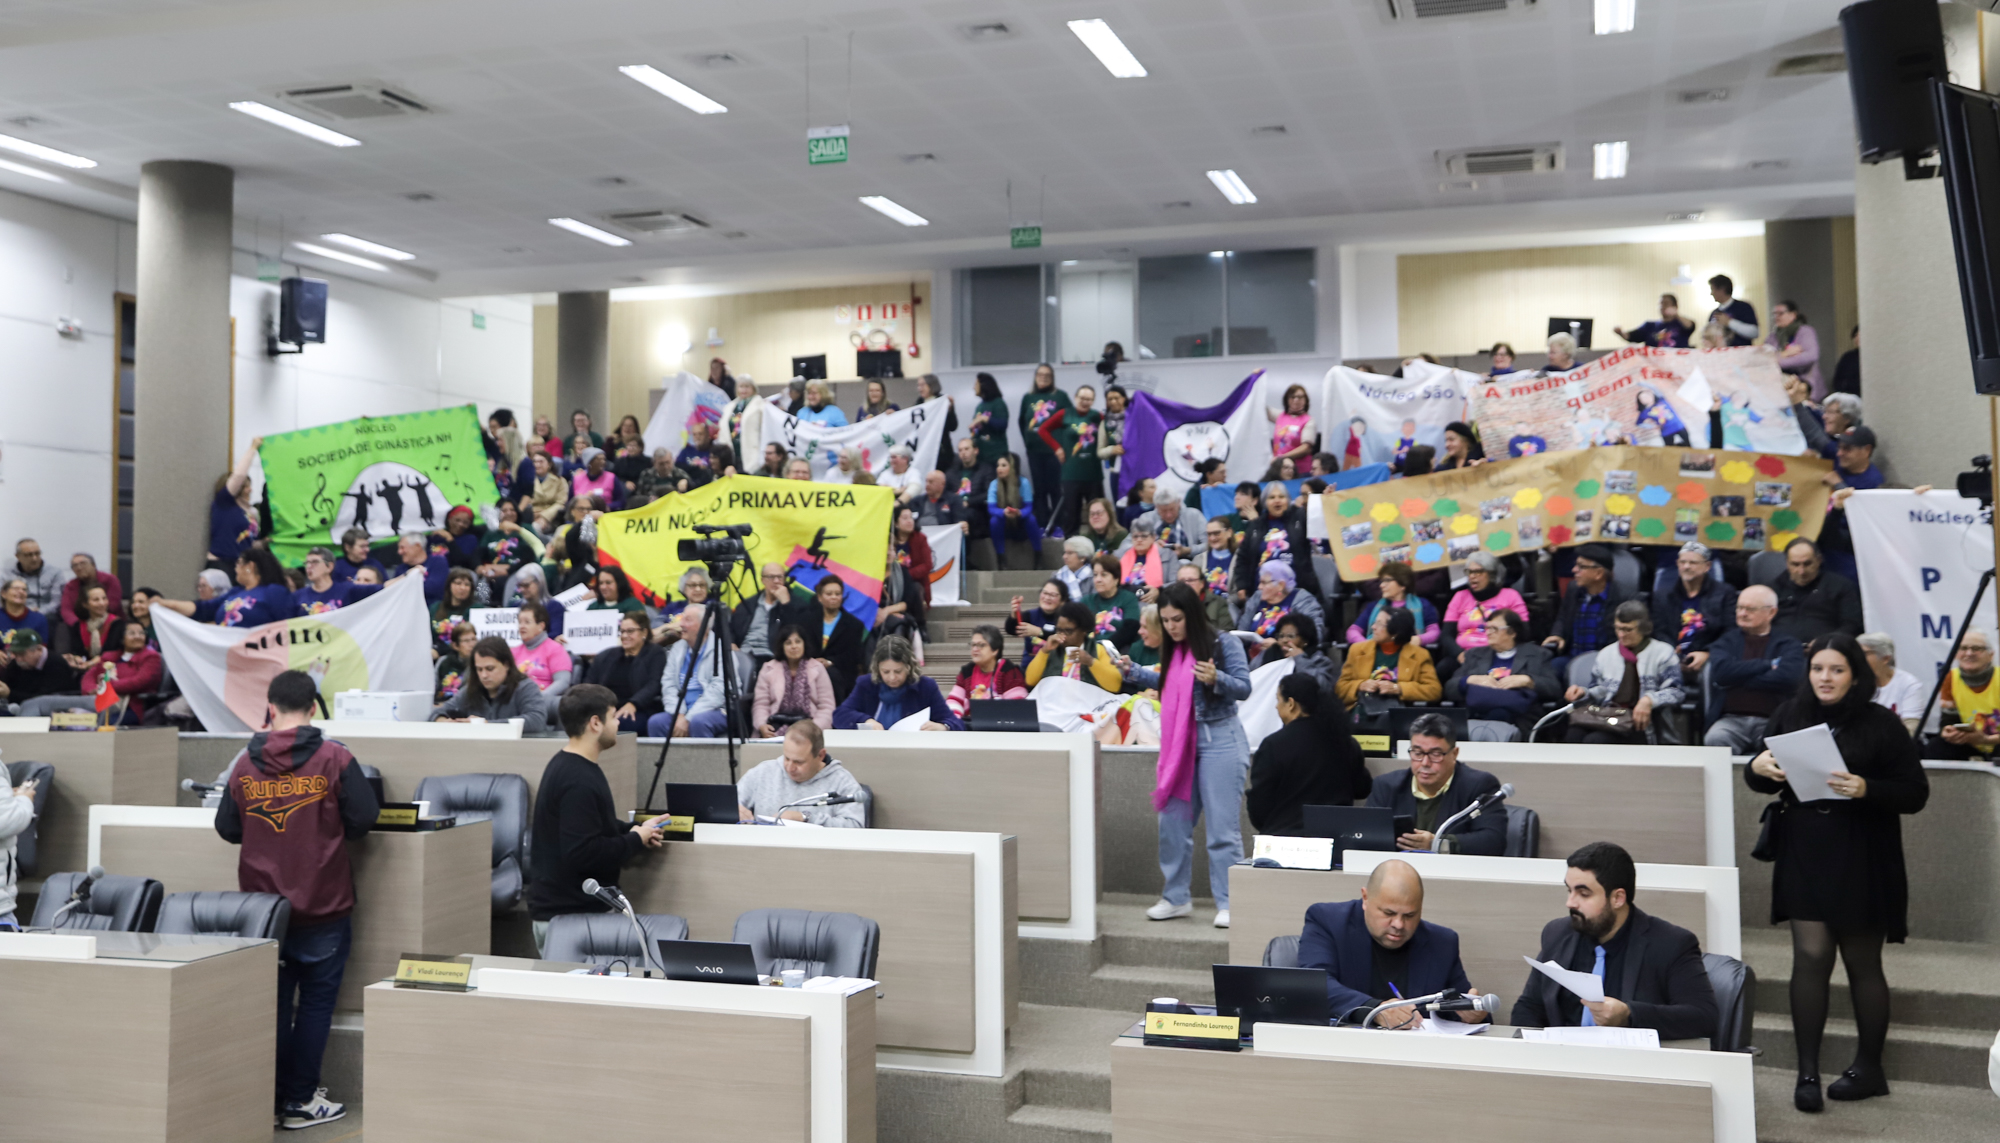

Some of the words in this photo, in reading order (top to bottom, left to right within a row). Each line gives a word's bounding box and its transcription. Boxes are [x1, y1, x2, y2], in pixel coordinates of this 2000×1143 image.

[1485, 386, 1502, 399] A
[1510, 367, 1590, 397] melhor
[1359, 383, 1416, 401] Núcleo
[1423, 384, 1455, 399] São
[1567, 374, 1632, 410] quem
[356, 423, 396, 434] NÚCLEO
[298, 441, 371, 469] SOCIEDADE
[375, 433, 434, 450] GINÁSTICA
[436, 432, 452, 443] NH
[625, 518, 659, 533] PMI
[729, 490, 856, 508] PRIMAVERA
[1909, 509, 1974, 524] Núcleo
[568, 623, 613, 639] INTEGRAÇÃO
[418, 967, 433, 975] Vladi
[435, 969, 463, 978] Lourenço
[695, 965, 724, 974] VAIO
[1173, 1020, 1208, 1029] Fernandinho
[1209, 1022, 1234, 1031] Lourenço
